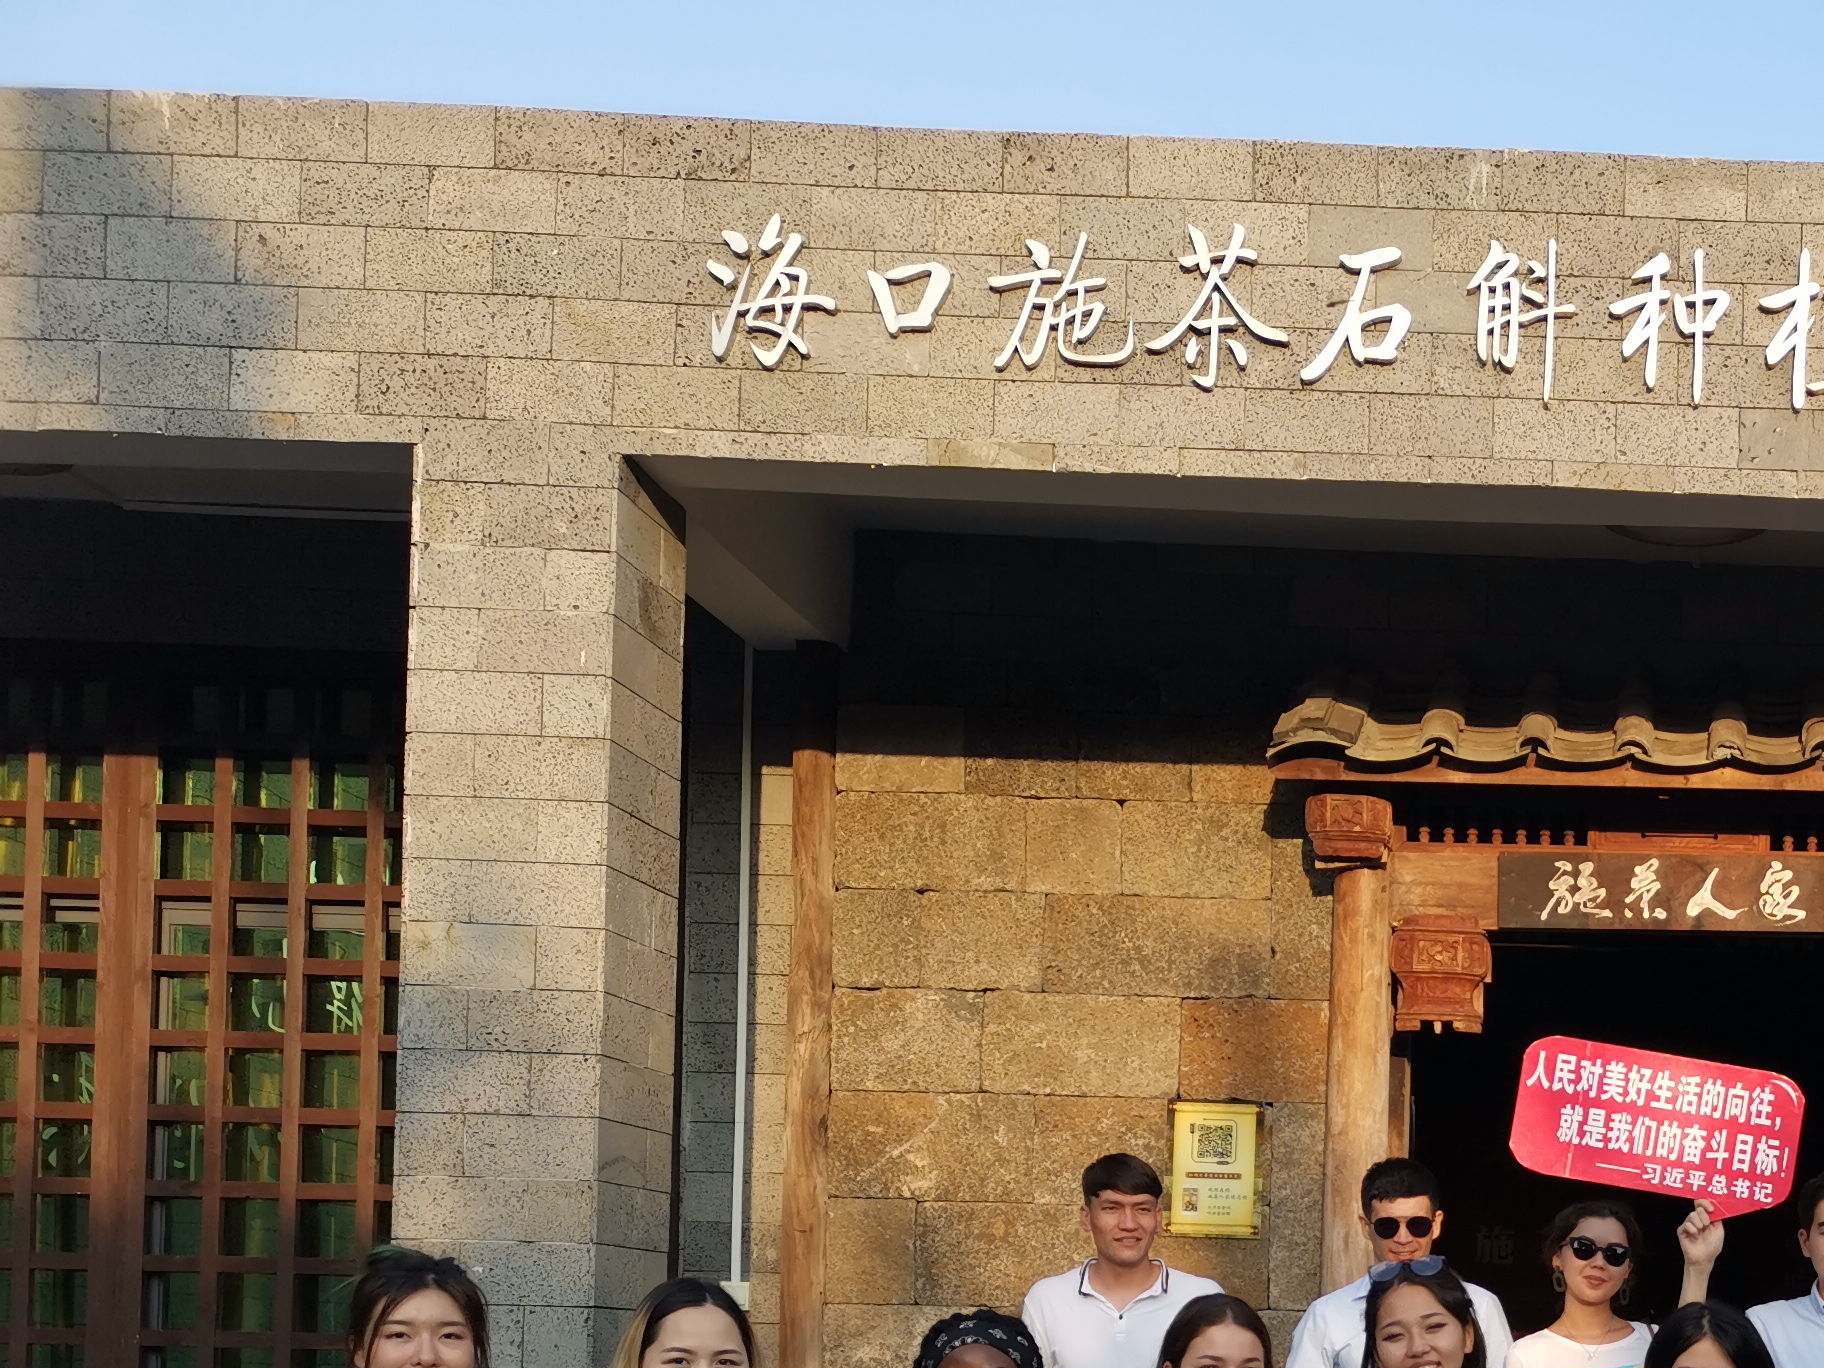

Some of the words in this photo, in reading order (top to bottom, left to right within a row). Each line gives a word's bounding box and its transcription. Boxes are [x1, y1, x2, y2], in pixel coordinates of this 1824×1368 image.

[1526, 1050, 1783, 1131] 人民对美好生活的向往，
[1556, 1104, 1789, 1178] 就是我们的奋斗目标！
